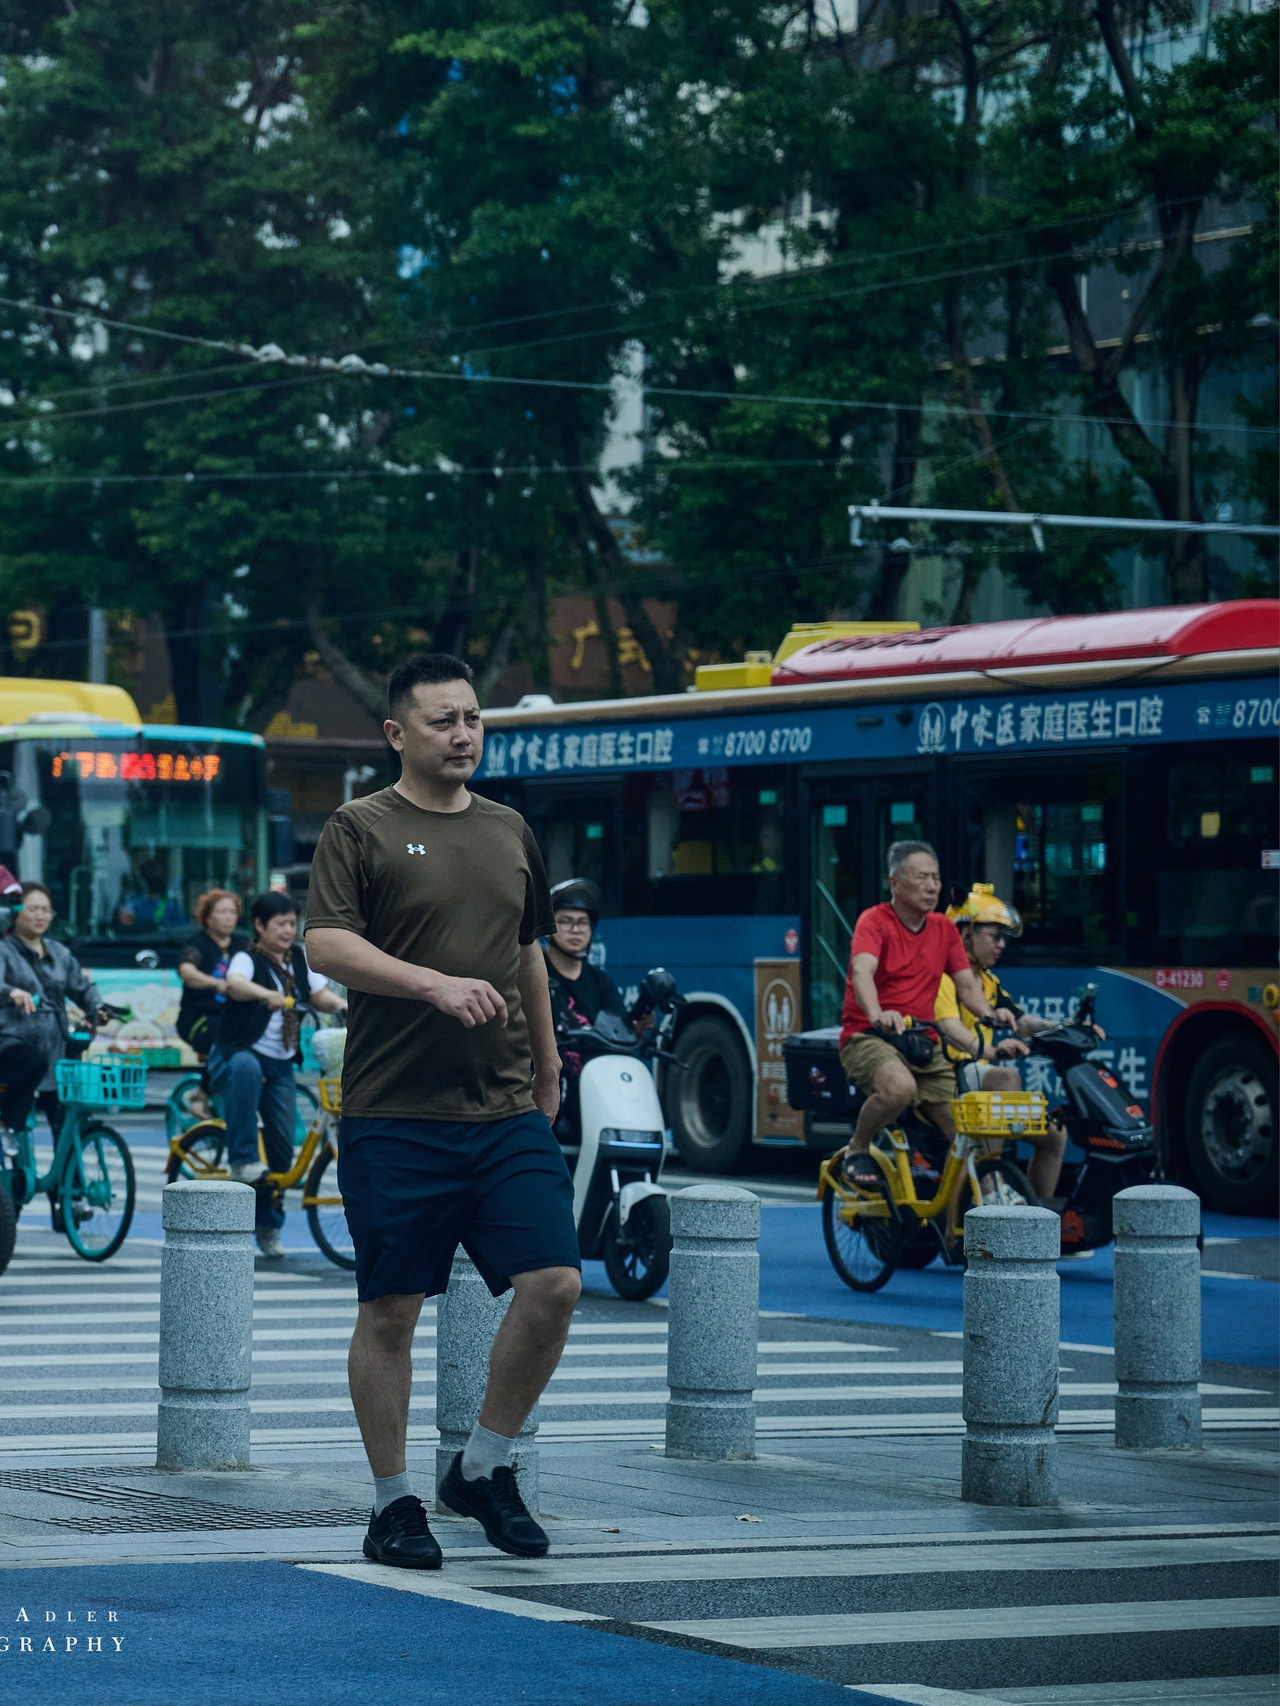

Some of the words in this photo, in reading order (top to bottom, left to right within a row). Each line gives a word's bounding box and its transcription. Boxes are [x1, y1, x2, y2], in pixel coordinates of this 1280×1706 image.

[725, 730, 766, 757] 8700
[769, 727, 812, 754] 8700
[1156, 969, 1204, 988] D-41230
